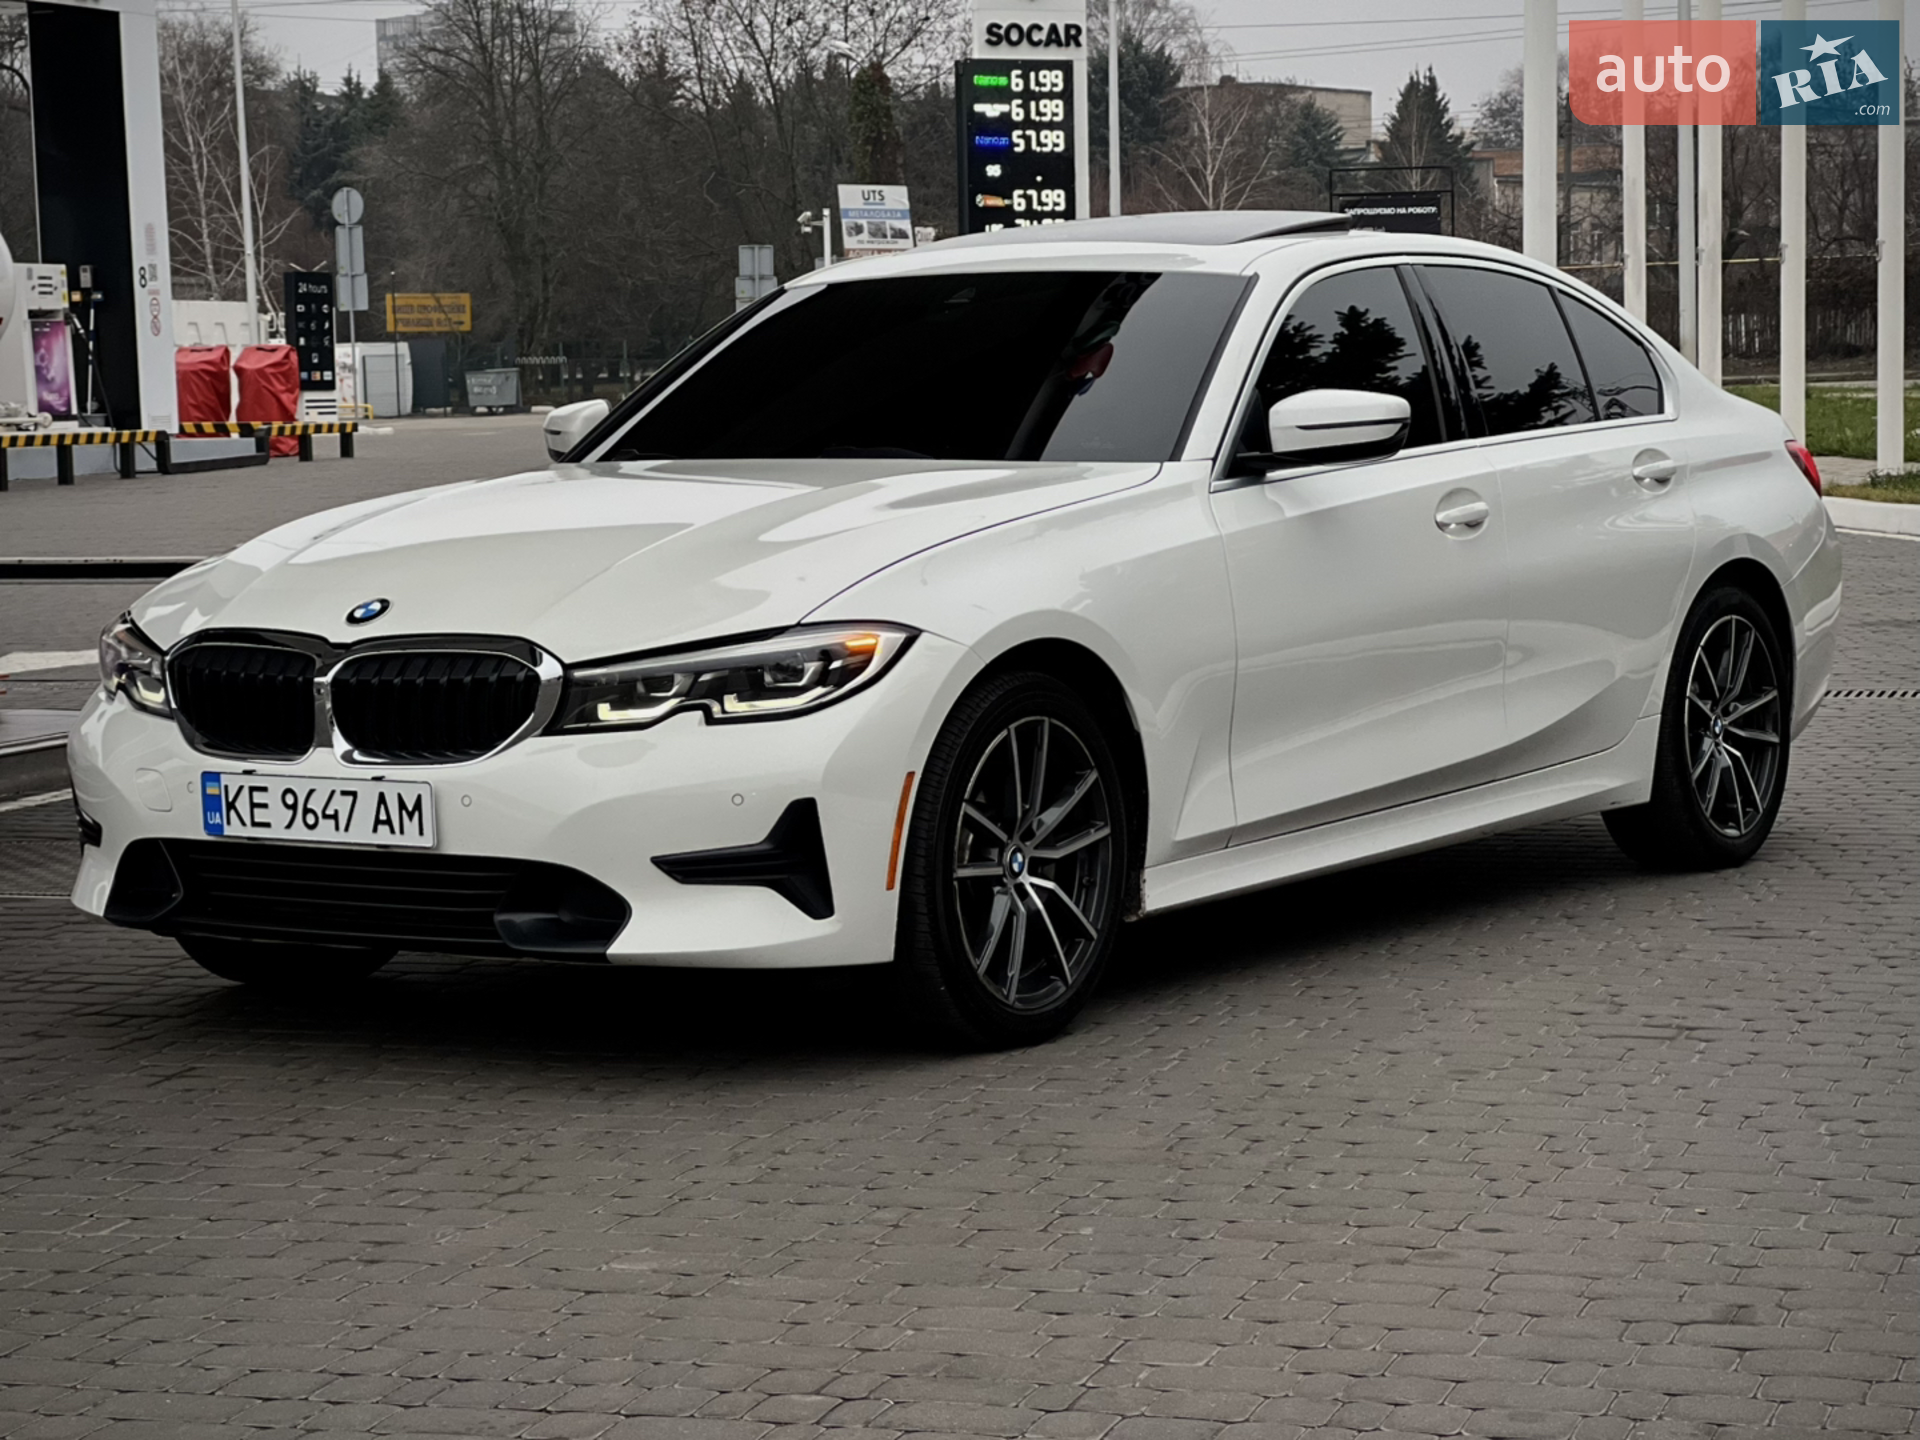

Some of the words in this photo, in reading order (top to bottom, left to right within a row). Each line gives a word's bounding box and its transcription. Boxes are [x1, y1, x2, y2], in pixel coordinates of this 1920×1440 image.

[985, 22, 1082, 48] SOCAR
[1011, 69, 1064, 92] 61.99
[1011, 99, 1065, 122] 61.99
[1012, 129, 1065, 152] 57.99
[861, 189, 885, 202] UTS
[1012, 189, 1066, 212] 67.99
[138, 266, 147, 288] 8
[308, 283, 328, 293] hours
[207, 811, 222, 825] UA
[223, 784, 272, 829] KE
[280, 787, 358, 833] 9647
[372, 791, 424, 836] AM
